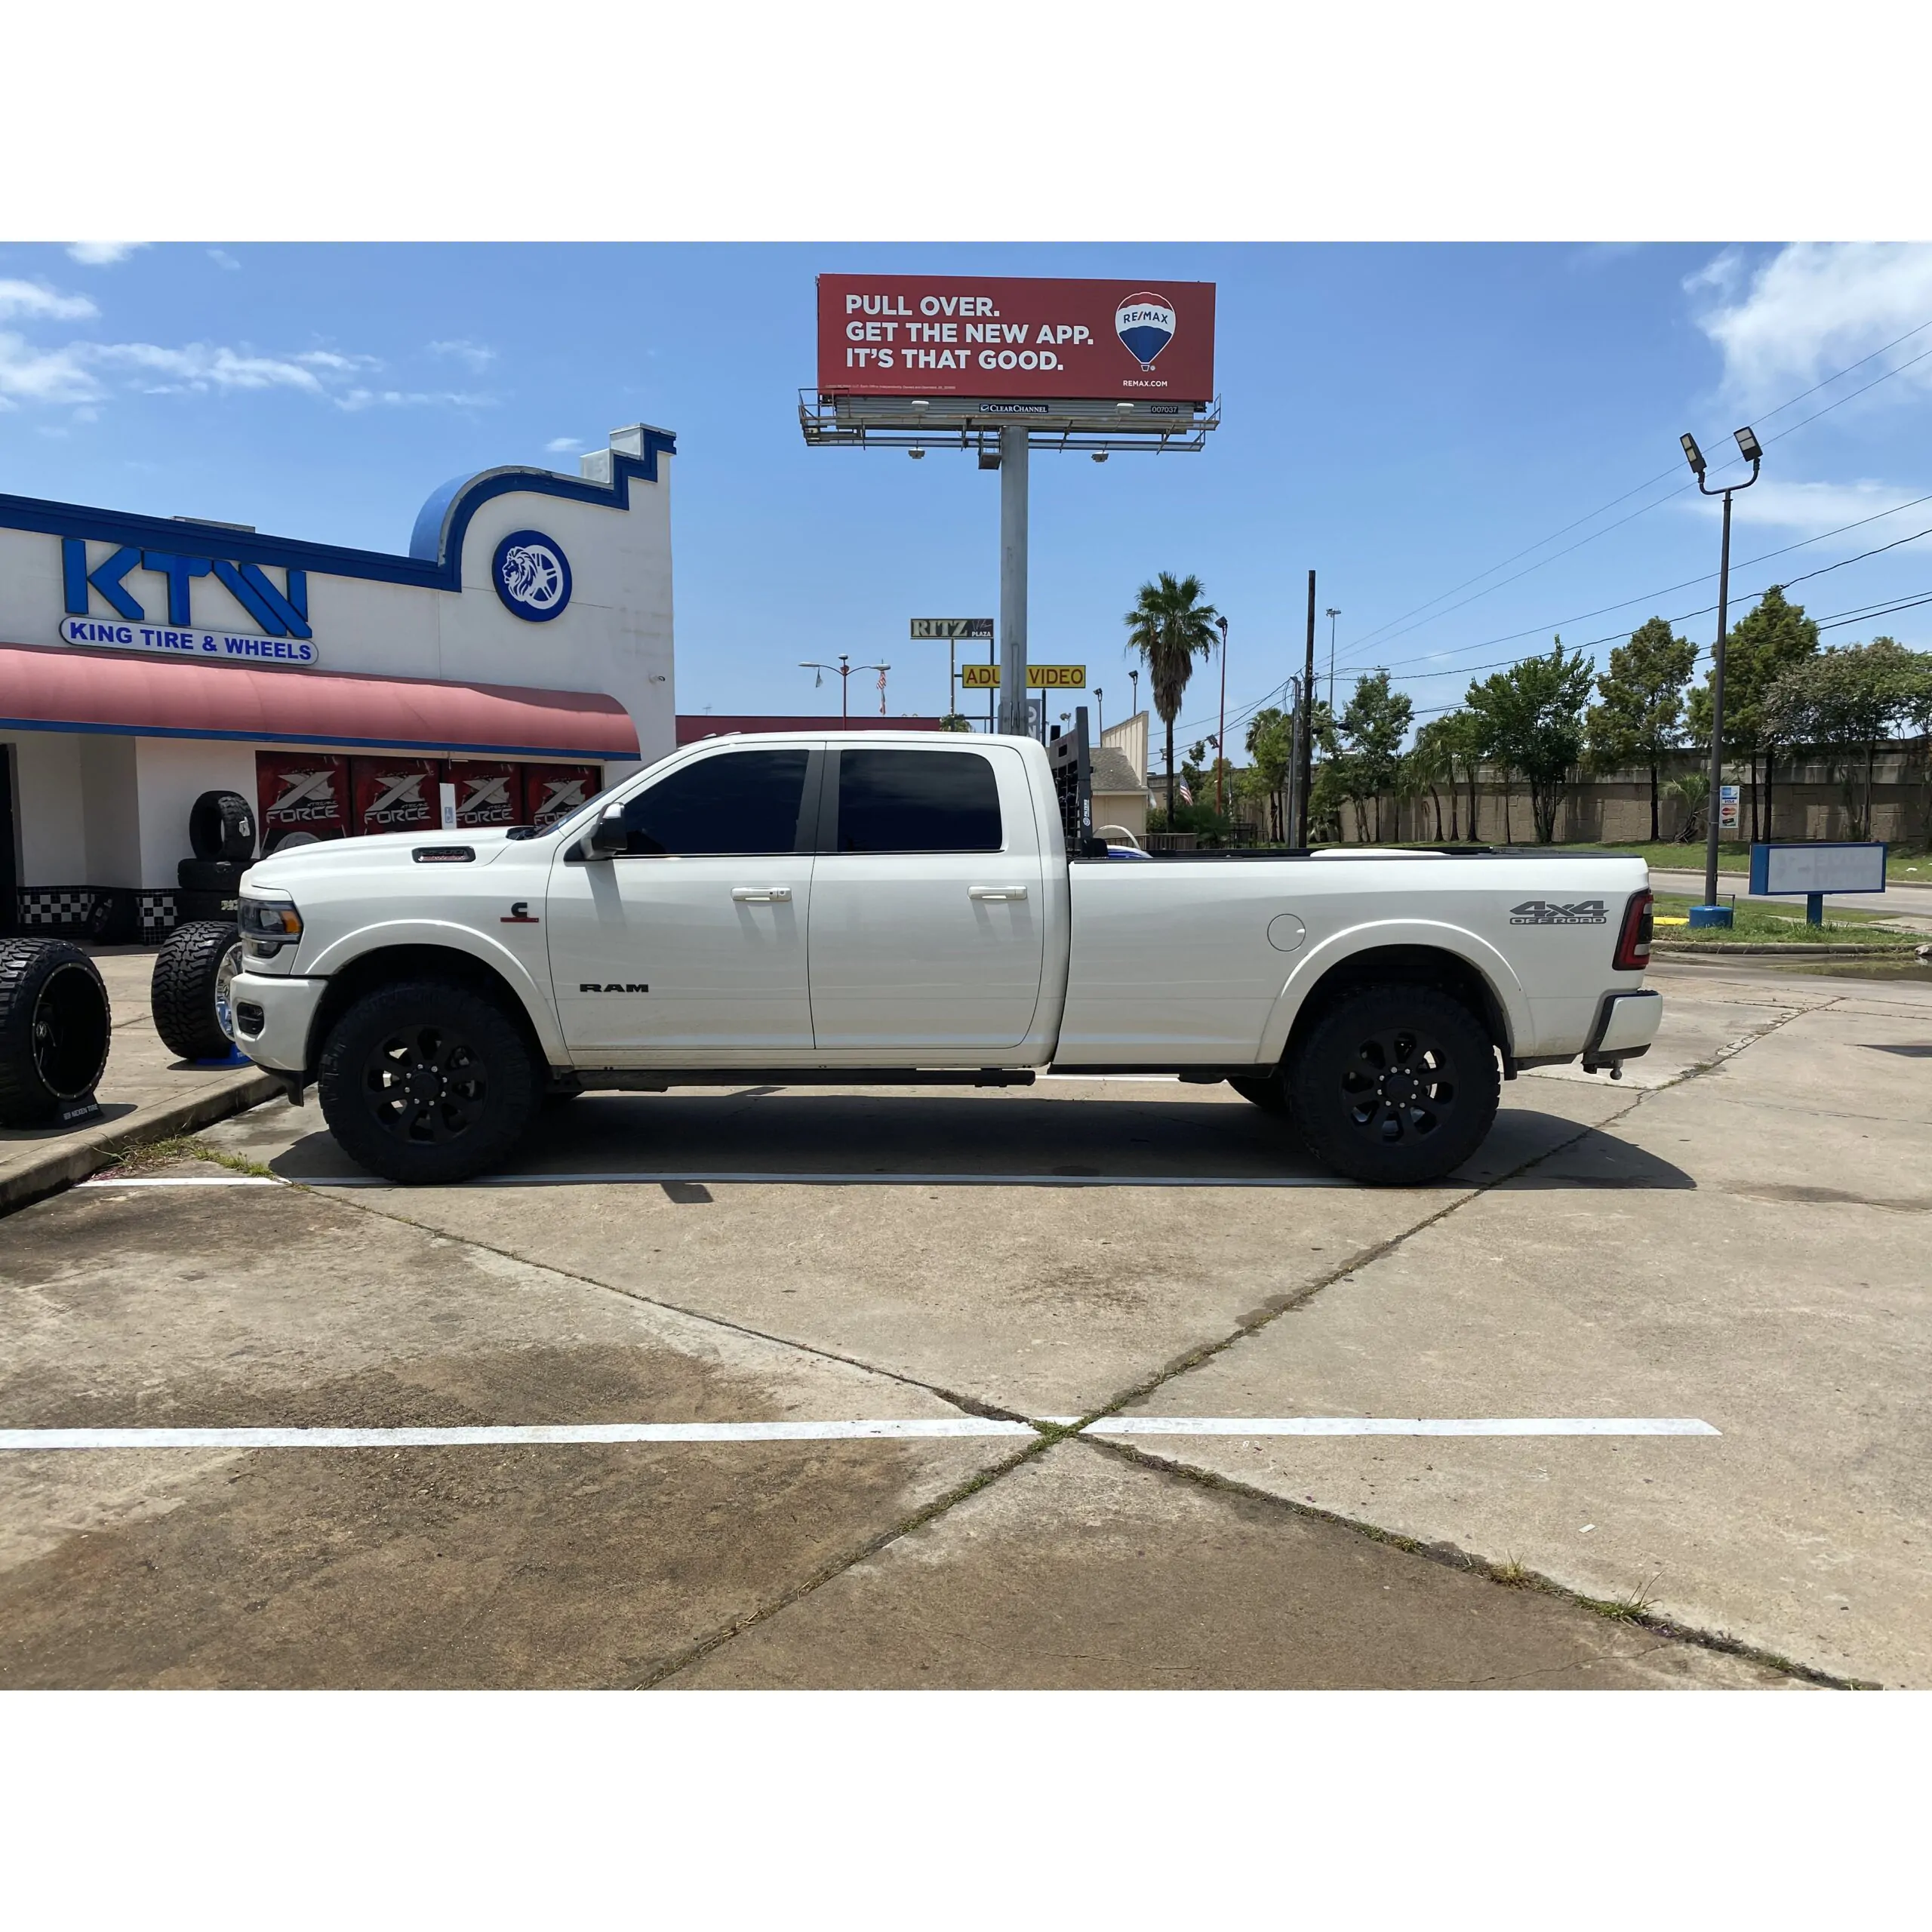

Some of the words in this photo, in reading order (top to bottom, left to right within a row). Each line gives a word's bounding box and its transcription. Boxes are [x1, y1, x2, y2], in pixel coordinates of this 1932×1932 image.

[846, 294, 912, 315] PULL
[920, 296, 1000, 316] OVER.
[1123, 311, 1168, 325] RE/MAX
[846, 321, 899, 341] GET
[906, 323, 958, 342] THE
[965, 324, 1029, 343] NEW
[1036, 325, 1094, 345] APP.
[846, 347, 894, 368] IT'S
[901, 349, 971, 368] THAT
[978, 349, 1064, 371] GOOD.
[912, 620, 968, 637] RITZ
[70, 622, 133, 644] KING
[140, 629, 194, 650] TIRE
[202, 635, 218, 652] &
[224, 637, 312, 660] WHEELS
[966, 668, 1000, 684] ADU
[1029, 668, 1083, 685] VIDEO
[266, 804, 340, 824] FORCE
[364, 806, 432, 825] FORCE
[580, 984, 649, 993] RAM
